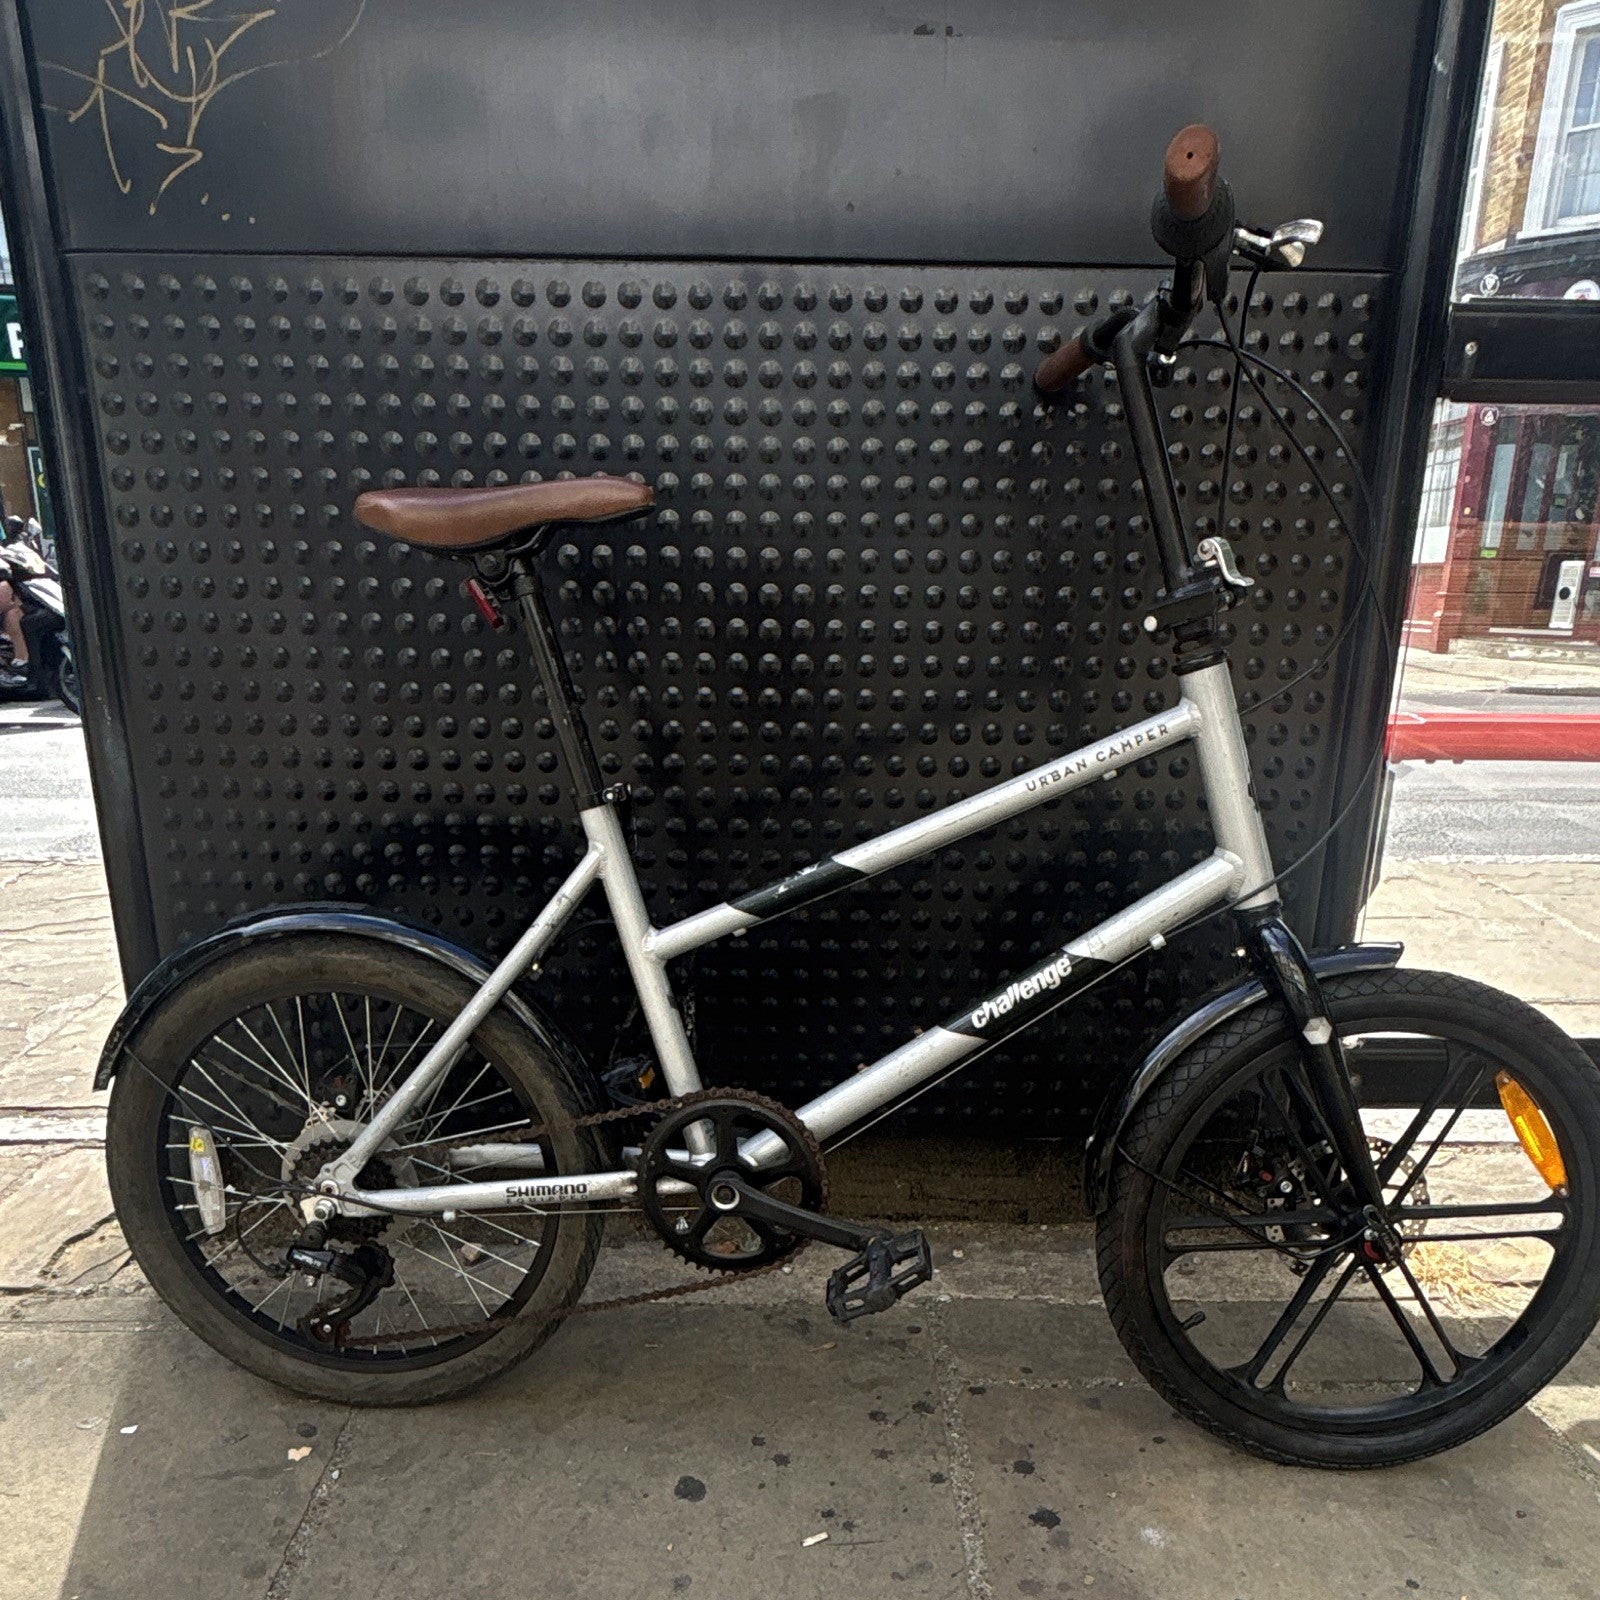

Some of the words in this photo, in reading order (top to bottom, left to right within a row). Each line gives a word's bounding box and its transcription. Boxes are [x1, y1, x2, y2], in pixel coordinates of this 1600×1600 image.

[1025, 758, 1087, 792] URBAN
[1095, 723, 1169, 762] CAMPER
[971, 955, 1073, 1029] challenge
[505, 1183, 588, 1198] SHIMANO
